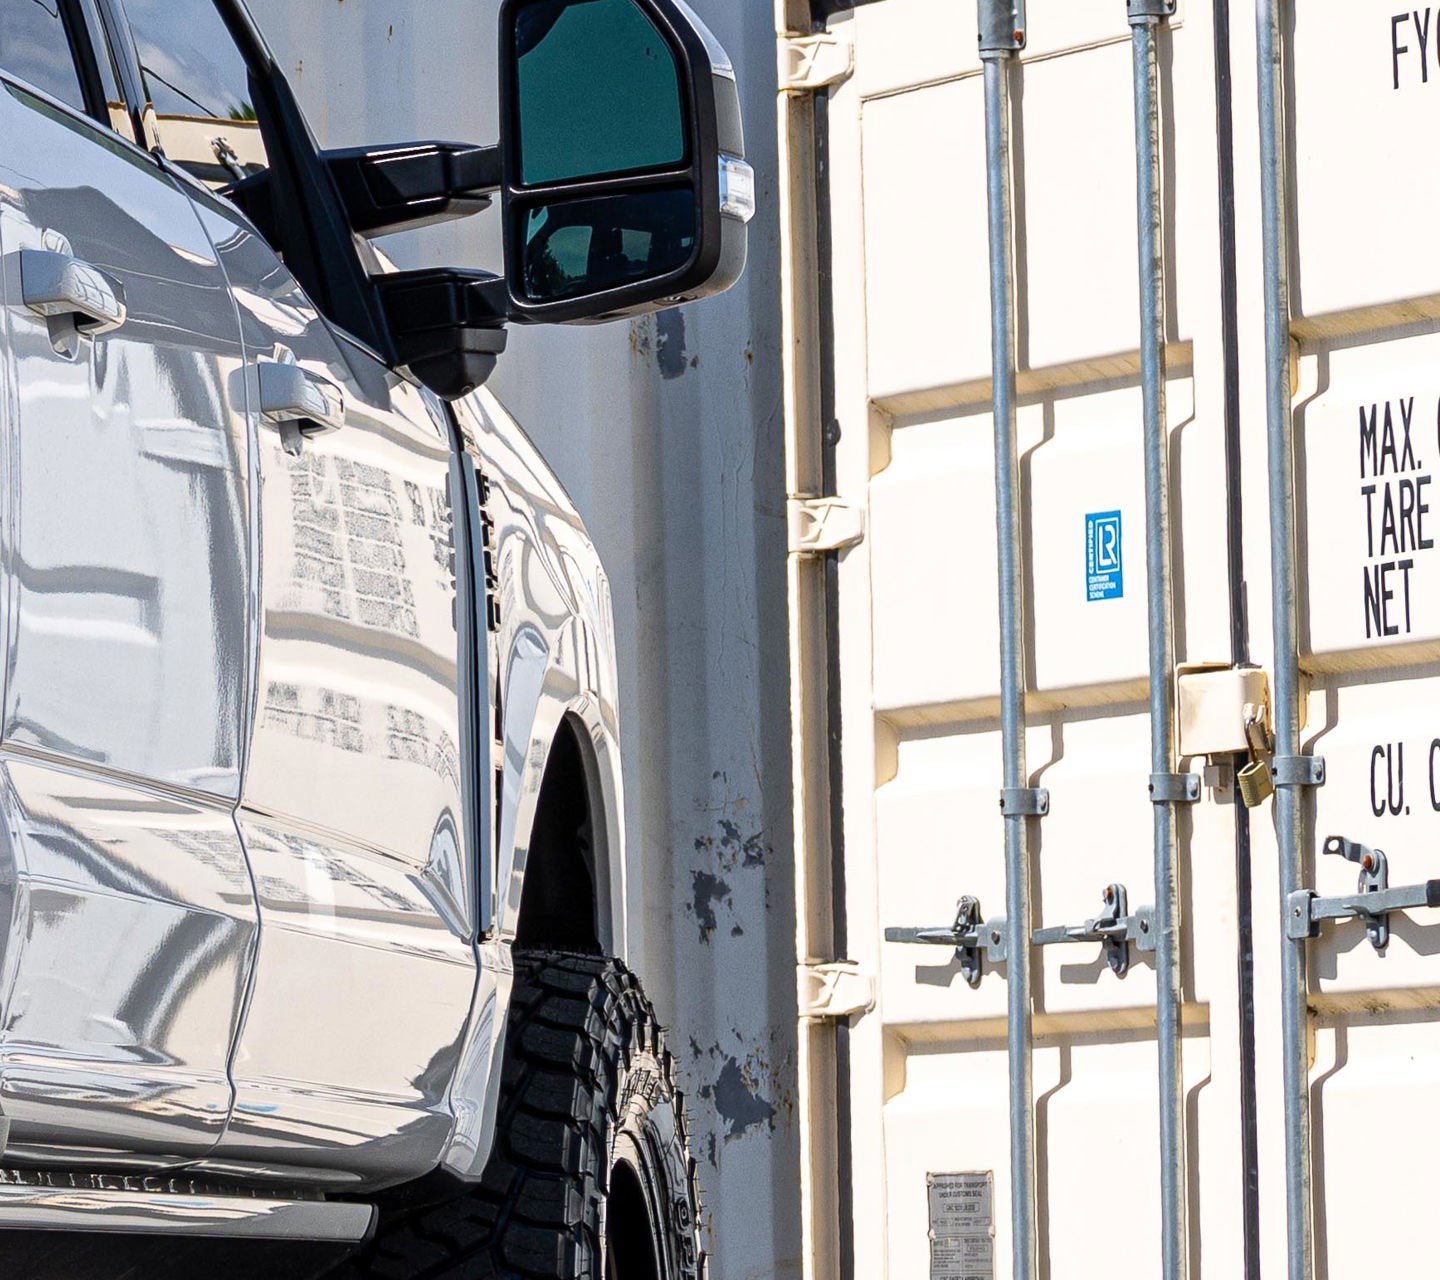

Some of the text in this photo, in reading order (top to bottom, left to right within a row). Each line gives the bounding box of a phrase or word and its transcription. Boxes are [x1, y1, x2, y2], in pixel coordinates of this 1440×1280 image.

[1391, 6, 1440, 89] FY
[1359, 396, 1422, 478] MAX.
[1361, 475, 1434, 557] TARE
[1364, 558, 1414, 638] NET
[1370, 741, 1410, 817] CU.
